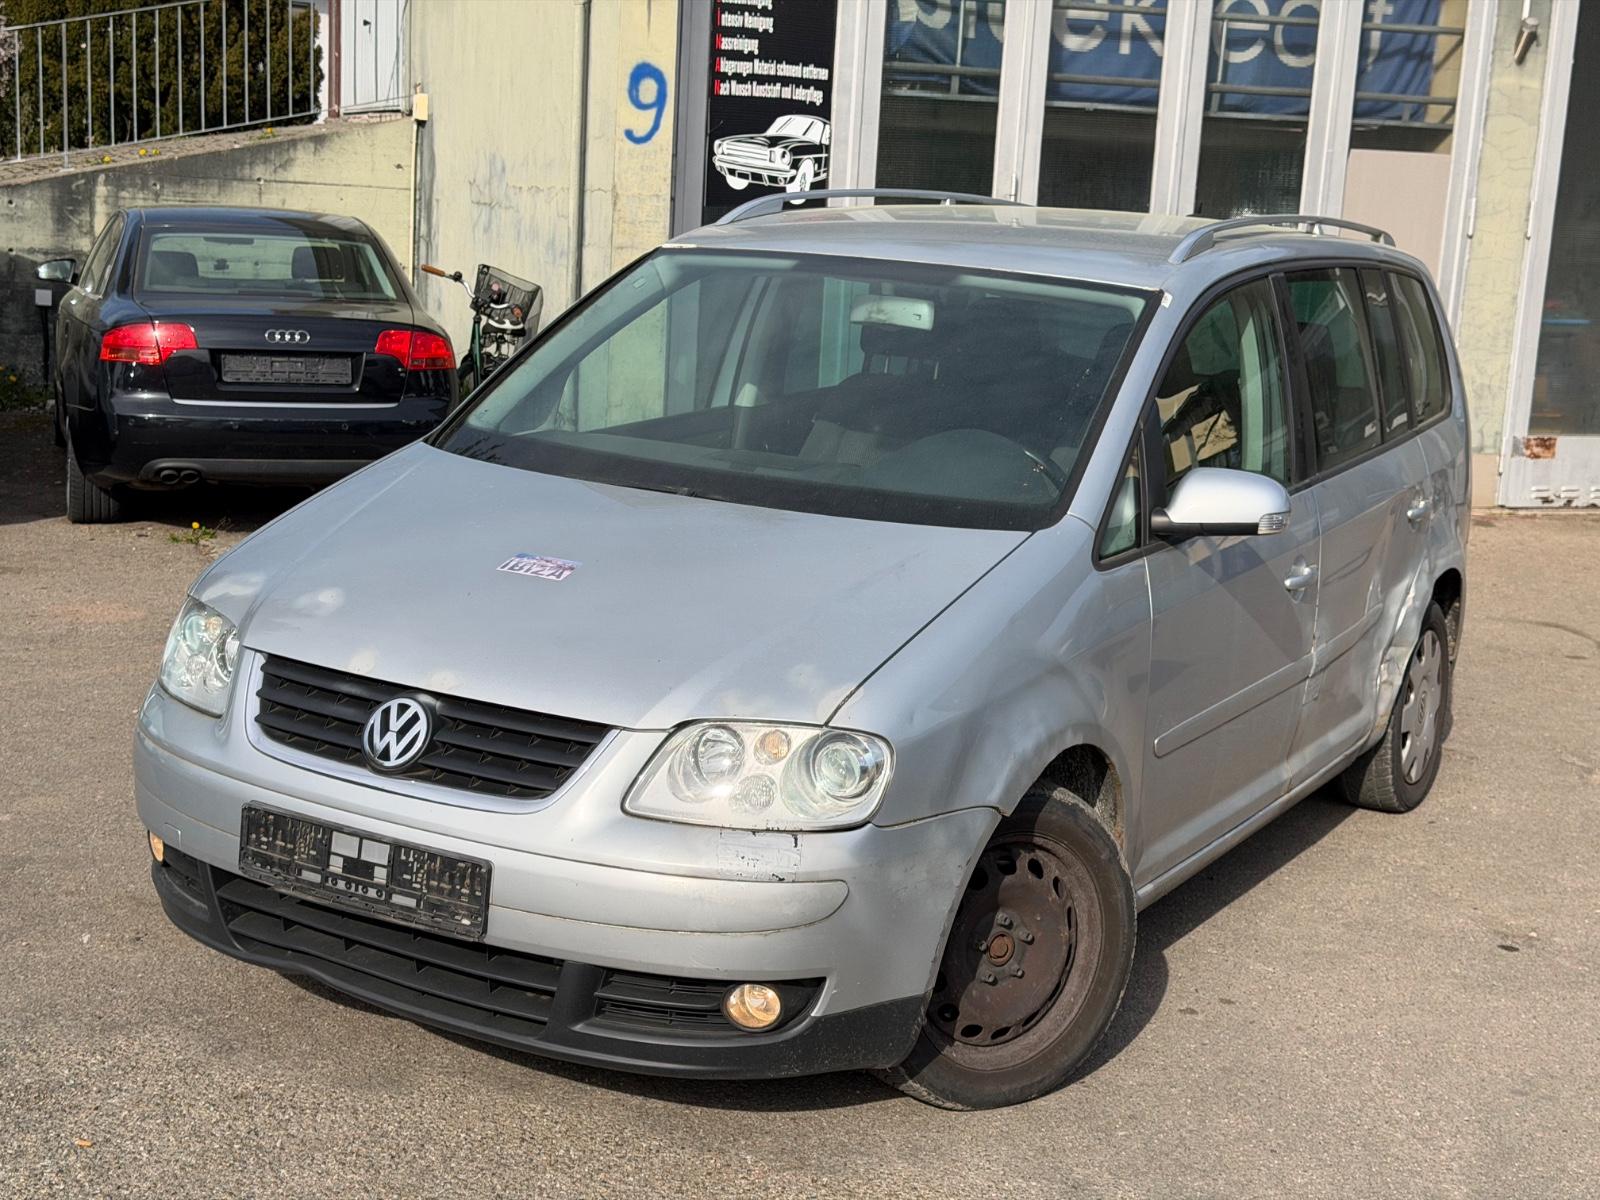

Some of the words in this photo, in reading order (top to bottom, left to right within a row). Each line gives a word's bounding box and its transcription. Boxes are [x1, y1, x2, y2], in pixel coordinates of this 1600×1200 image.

[744, 11, 774, 33] Reinigung
[716, 33, 759, 55] Nassreinigung
[715, 57, 753, 77] Ablagerungen
[753, 58, 777, 76] Material
[776, 60, 803, 78] schonend
[802, 63, 829, 80] entfernen
[624, 61, 668, 145] 9
[714, 79, 730, 96] Nach
[731, 80, 752, 97] Wunsch
[752, 81, 781, 98] Kunststoff
[781, 83, 792, 99] und
[792, 83, 824, 106] Lederpflege
